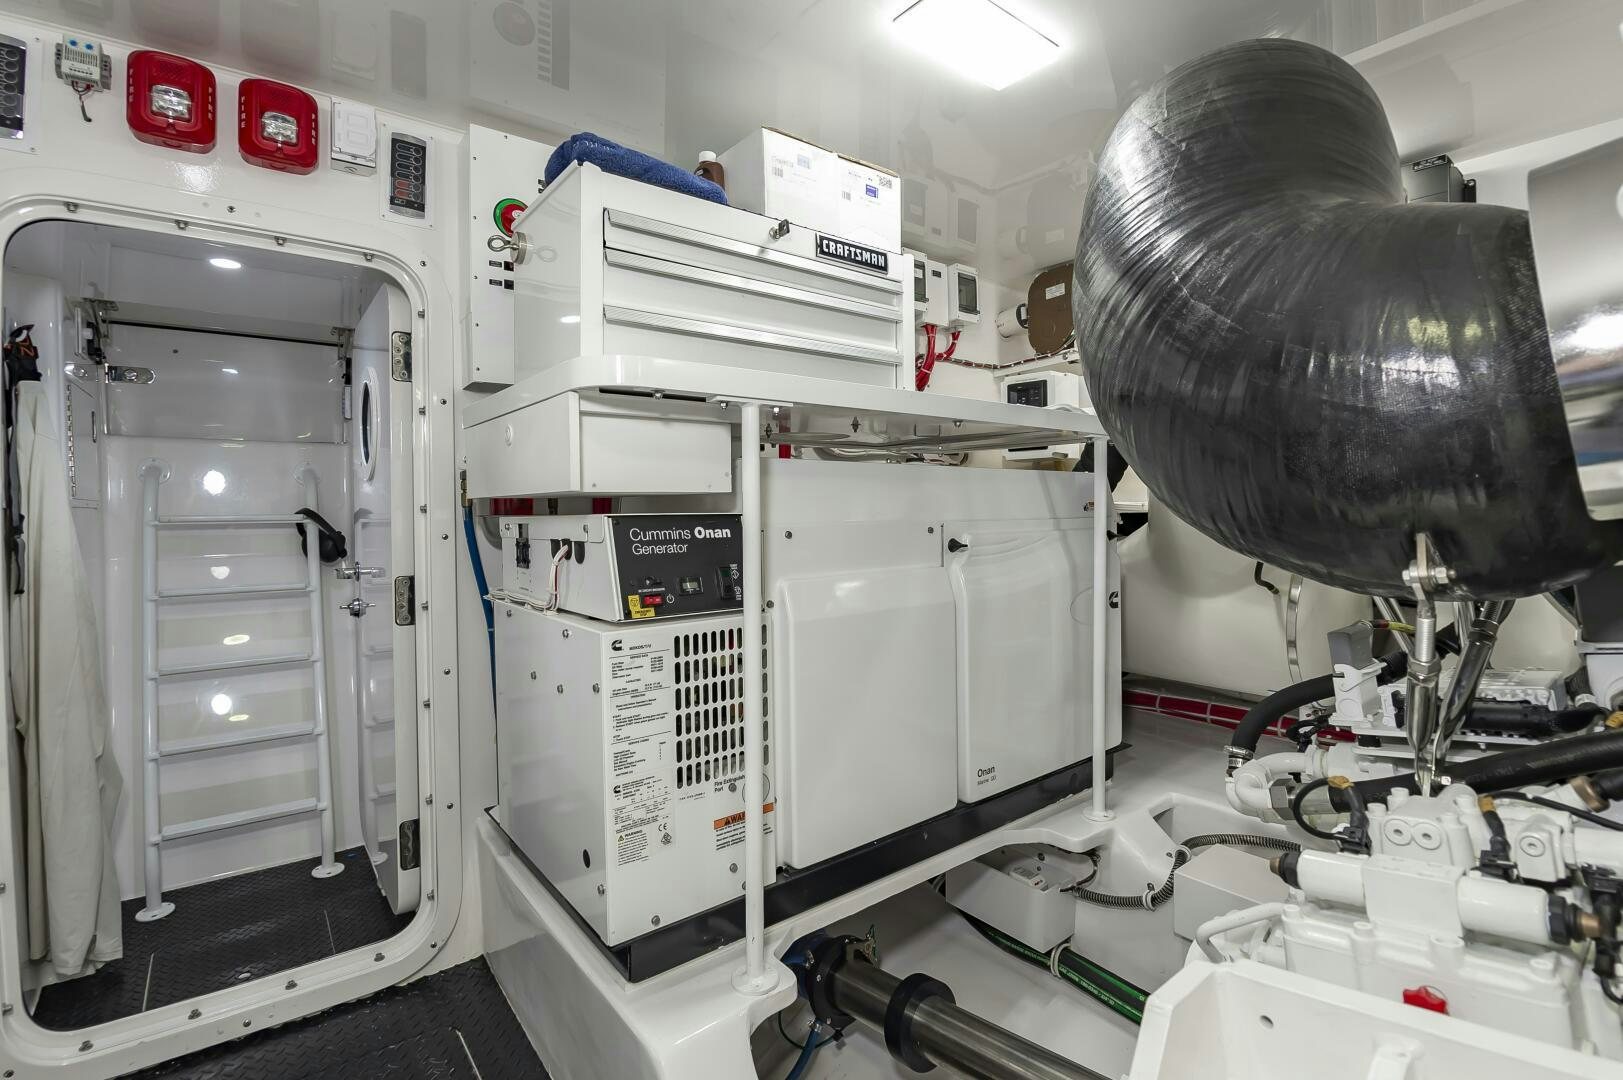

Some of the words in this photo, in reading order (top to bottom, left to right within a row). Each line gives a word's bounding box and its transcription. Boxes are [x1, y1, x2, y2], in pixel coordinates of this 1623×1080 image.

[822, 239, 885, 268] CRAFTSMAN
[629, 527, 691, 541] Cummins
[694, 526, 731, 539] Onan
[632, 543, 688, 555] Generator
[977, 766, 995, 778] Onan
